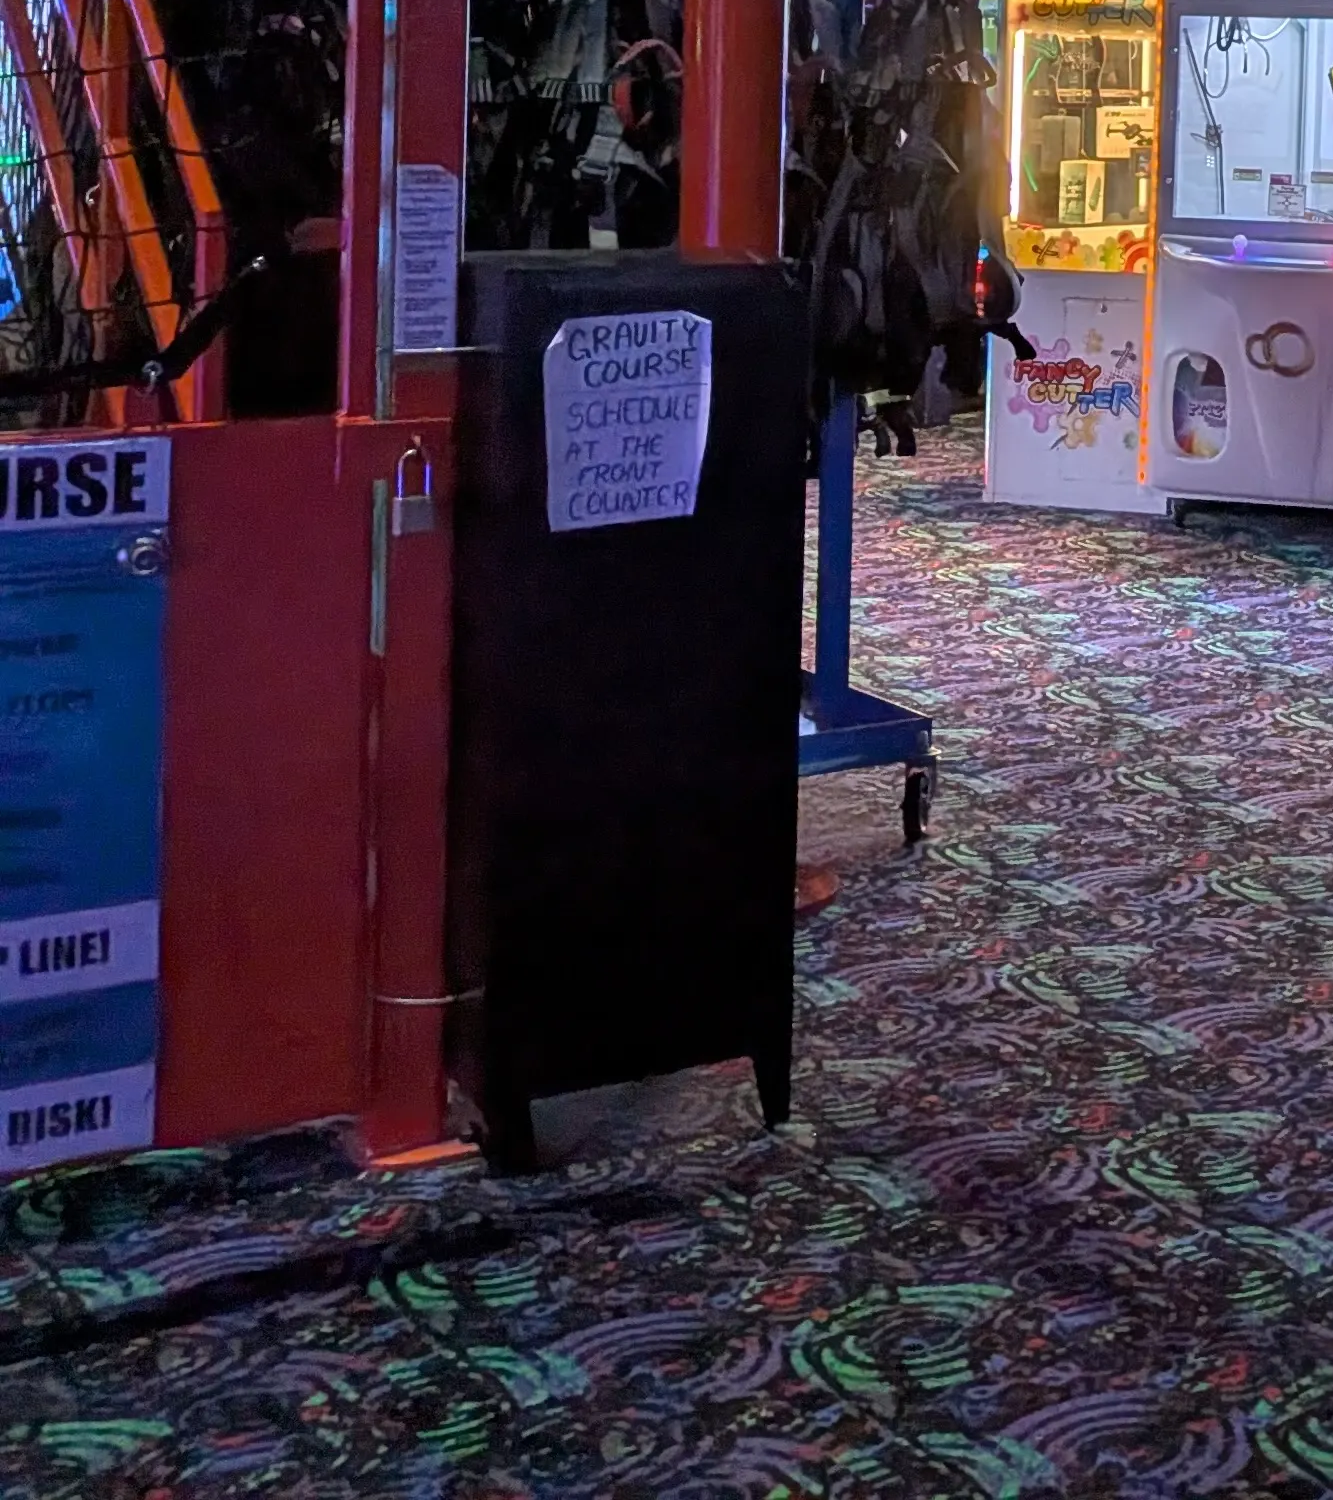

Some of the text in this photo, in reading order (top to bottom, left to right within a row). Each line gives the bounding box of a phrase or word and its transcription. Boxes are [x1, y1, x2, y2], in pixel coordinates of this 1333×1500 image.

[583, 347, 697, 388] COURSE
[1014, 357, 1101, 392] FANCY
[566, 394, 700, 432] SCHEDULE
[1027, 381, 1140, 418] CUTTER
[565, 434, 664, 462] AT THE
[0, 451, 148, 522] RSE
[578, 460, 662, 486] FRONT
[568, 480, 690, 521] COUNTER
[19, 928, 110, 976] LINE!
